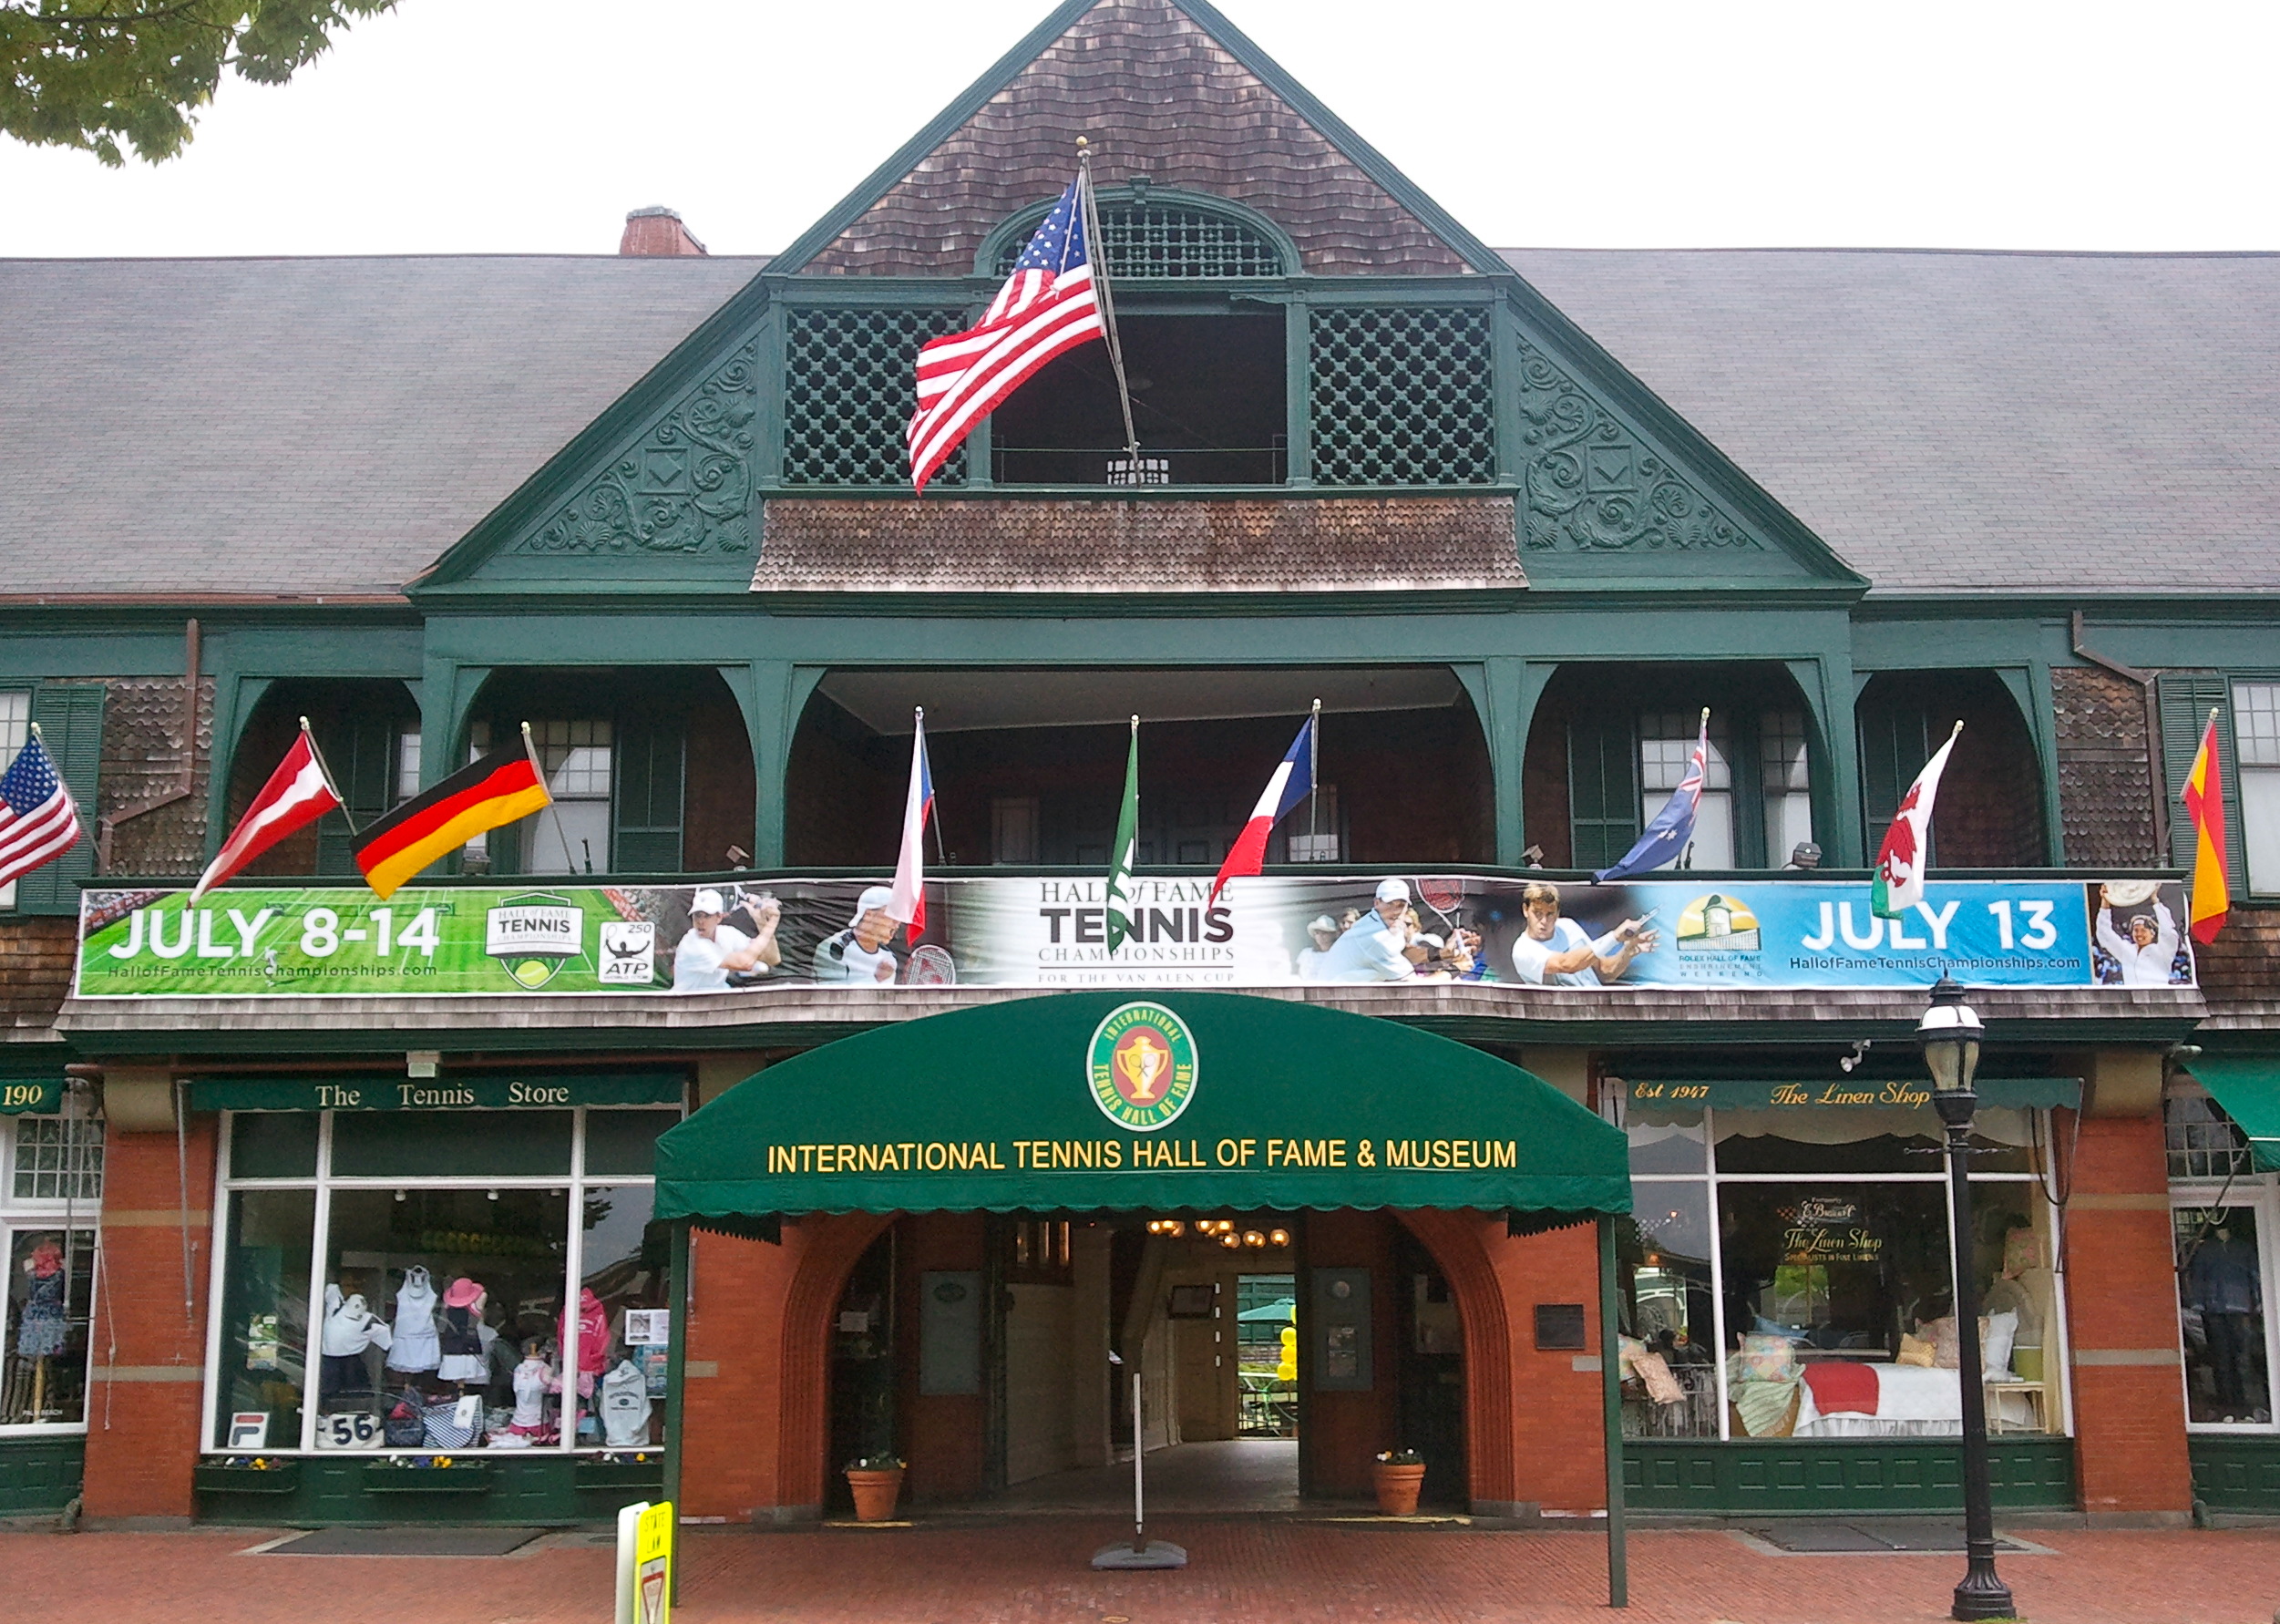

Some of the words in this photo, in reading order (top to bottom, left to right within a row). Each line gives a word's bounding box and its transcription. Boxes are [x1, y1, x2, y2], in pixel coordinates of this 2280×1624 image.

[1154, 882, 1234, 902] FAME
[108, 909, 272, 959] JULY
[300, 907, 440, 957] 8-14
[498, 919, 570, 934] TENNIS
[628, 924, 652, 933] 250
[1040, 908, 1234, 943] TENNIS
[1801, 900, 1961, 951] JULY
[1988, 899, 2059, 950] 13
[1038, 948, 1234, 961] CHAMPIONSHIPS
[1790, 956, 2080, 970] HallofFameTennisChampionships.com
[108, 964, 437, 978] HallofFameTennisChampionships.com
[605, 962, 649, 975] ATP
[1038, 973, 1068, 983] FOR
[1078, 972, 1108, 983] THE
[1117, 972, 1146, 982] VAN
[1155, 972, 1195, 982] ALEN
[1204, 972, 1235, 982] CUP
[1104, 1009, 1182, 1042] INTERNATIONAL
[3, 1084, 43, 1105] 190
[315, 1084, 361, 1106] The
[397, 1083, 475, 1105] Tennis
[508, 1081, 570, 1104] Store
[1093, 1064, 1123, 1112] TENNIS
[1121, 1105, 1157, 1125] HALL
[1158, 1097, 1177, 1117] OF
[1170, 1064, 1193, 1099] FAME
[1635, 1083, 1666, 1099] Est
[1669, 1084, 1710, 1099] 1947
[1770, 1082, 1809, 1105] The
[1814, 1082, 1874, 1105] Linen
[1879, 1081, 1931, 1109] Shop
[767, 1142, 1005, 1173] INTERNATIONAL
[1012, 1140, 1123, 1169] TENNIS
[1133, 1139, 1207, 1167] HALL
[1216, 1138, 1257, 1167] OF
[1267, 1139, 1347, 1167] FAME
[1357, 1139, 1377, 1167] &
[1386, 1139, 1517, 1168] MUSEUM
[1783, 1228, 1809, 1249] The
[1807, 1228, 1844, 1253] Linen
[1848, 1228, 1883, 1252] Shop
[332, 1413, 374, 1446] 56
